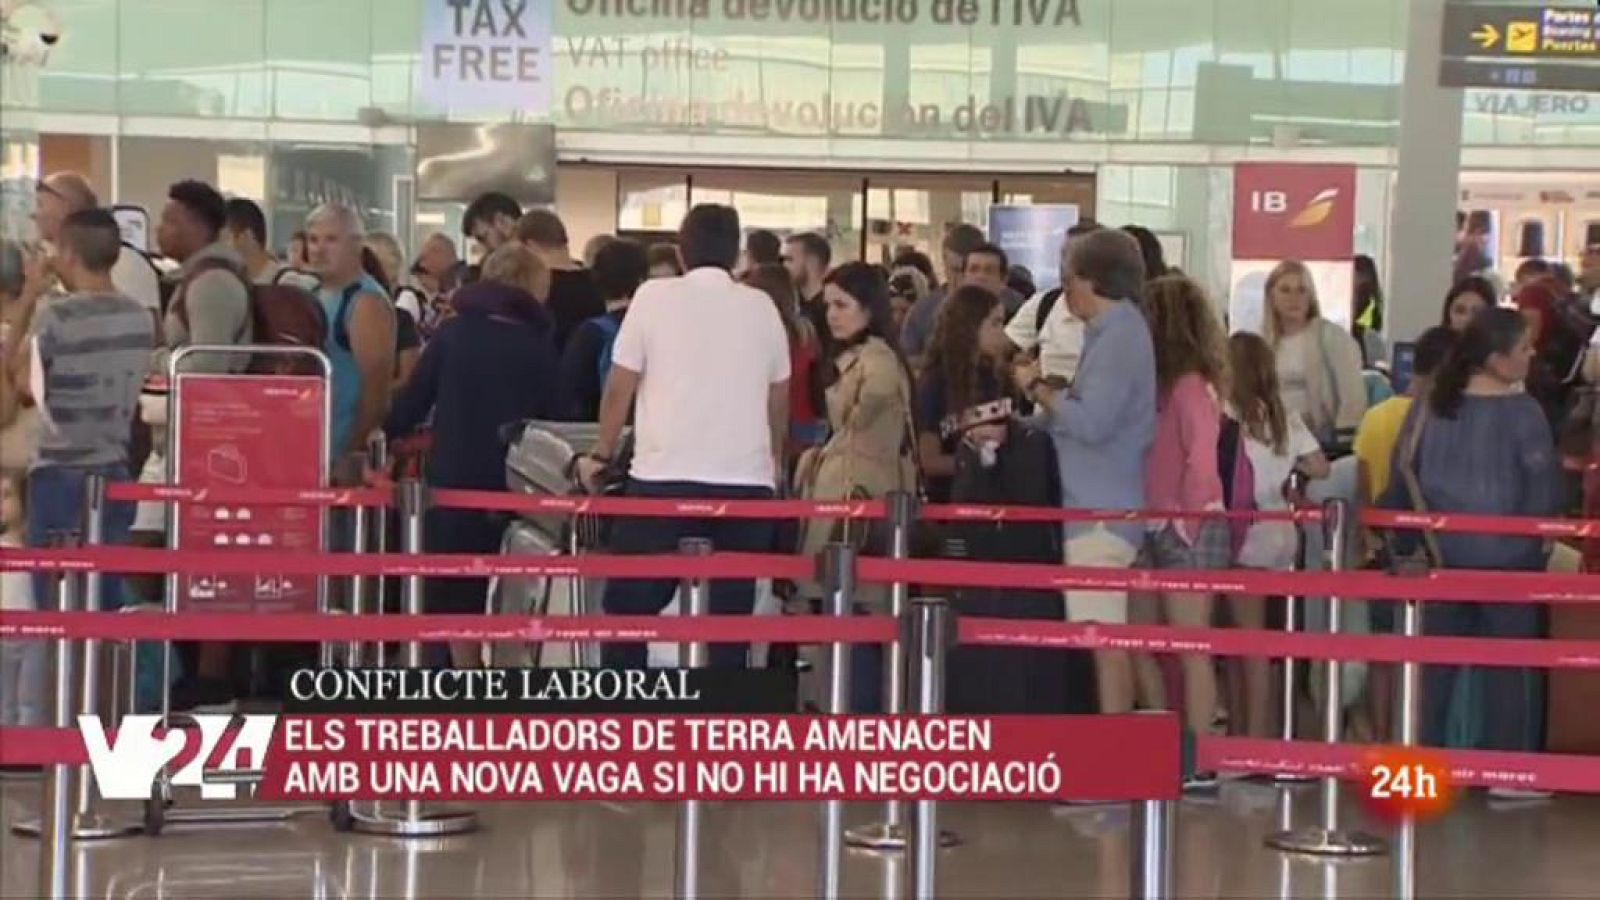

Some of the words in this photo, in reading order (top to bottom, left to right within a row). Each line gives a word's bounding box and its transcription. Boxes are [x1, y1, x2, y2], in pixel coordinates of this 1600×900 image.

[449, 0, 526, 37] TAX
[432, 45, 541, 81] FREE
[567, 36, 630, 68] VAT
[1023, 95, 1095, 134] IVA
[1475, 93, 1589, 114] VIAJERO
[1251, 191, 1288, 212] IB
